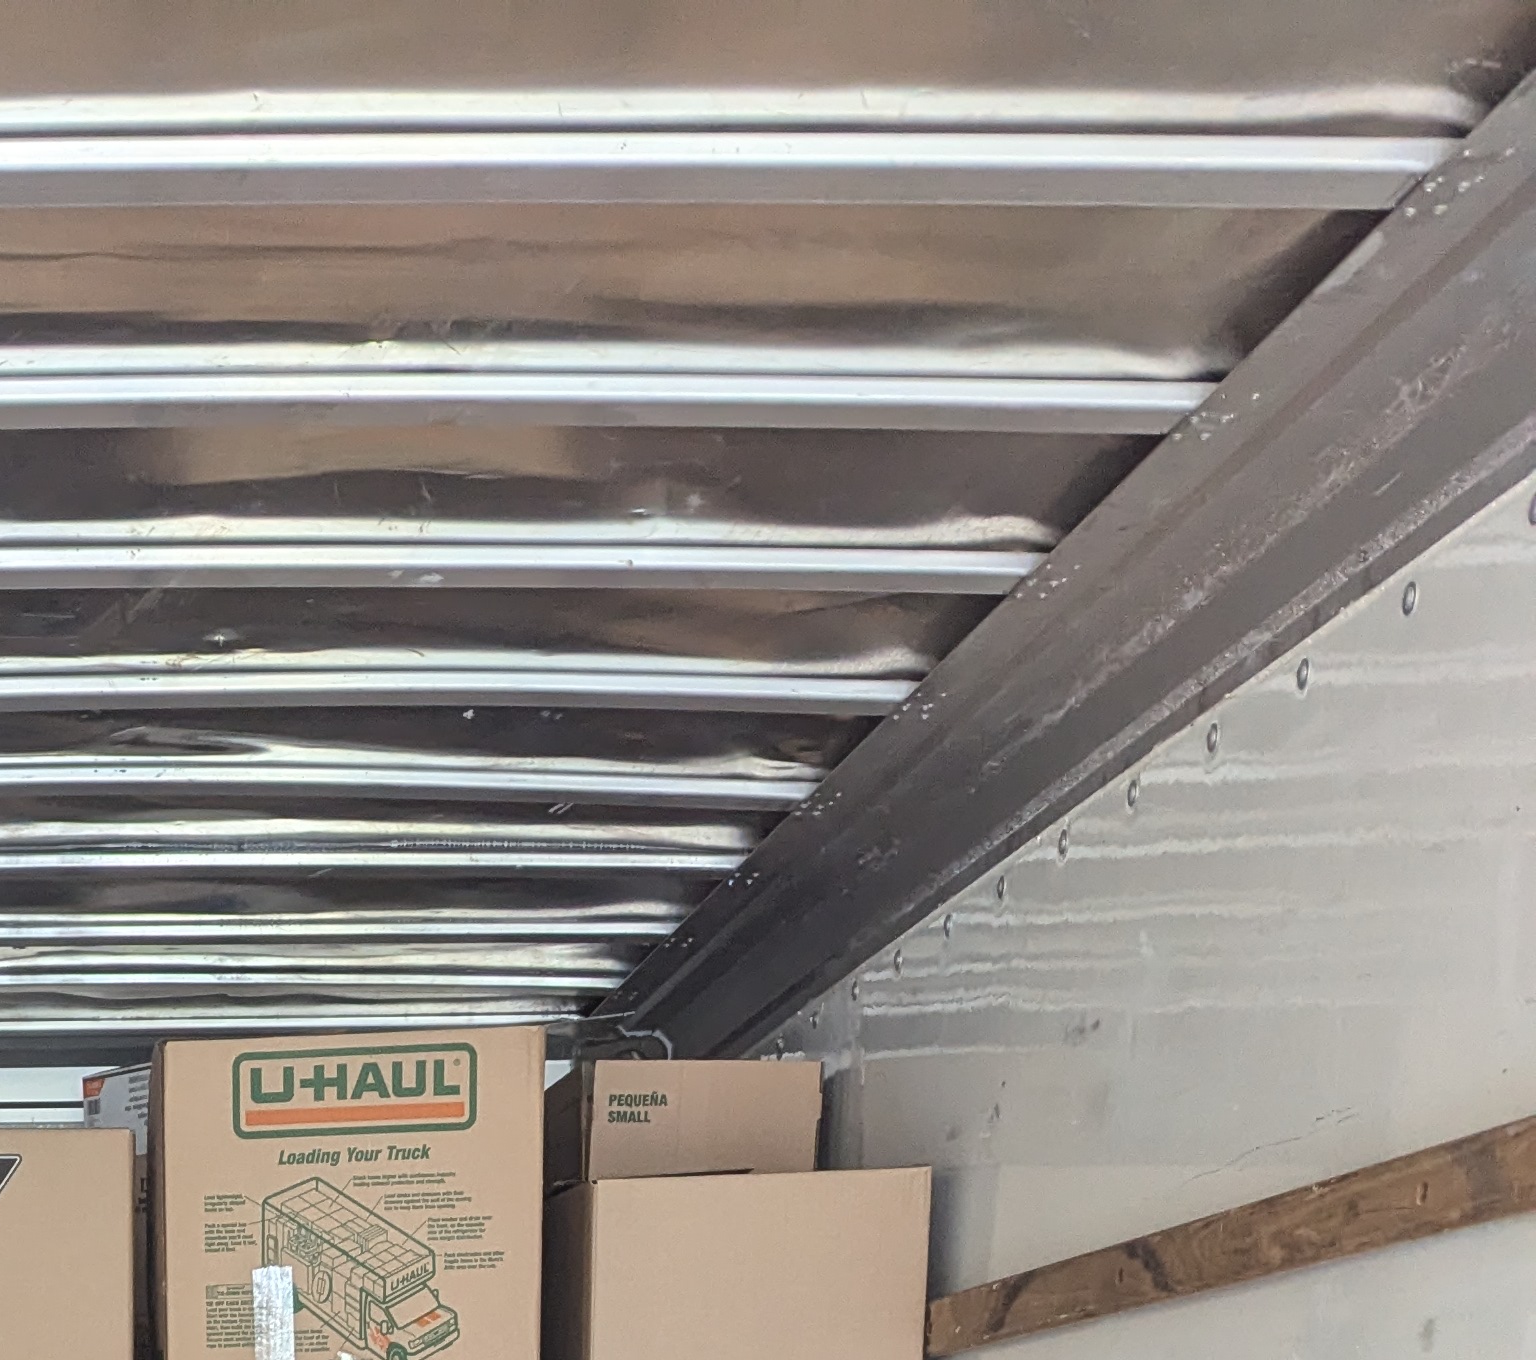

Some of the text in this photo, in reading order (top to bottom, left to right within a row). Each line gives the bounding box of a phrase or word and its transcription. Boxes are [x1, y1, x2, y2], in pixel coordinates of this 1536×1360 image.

[250, 1059, 460, 1104] U-HAUL
[608, 1090, 668, 1108] PEQUEÑA
[607, 1110, 651, 1123] SMALL
[278, 1143, 431, 1167] Loading Your Truck
[390, 1263, 429, 1291] U-HAUL
